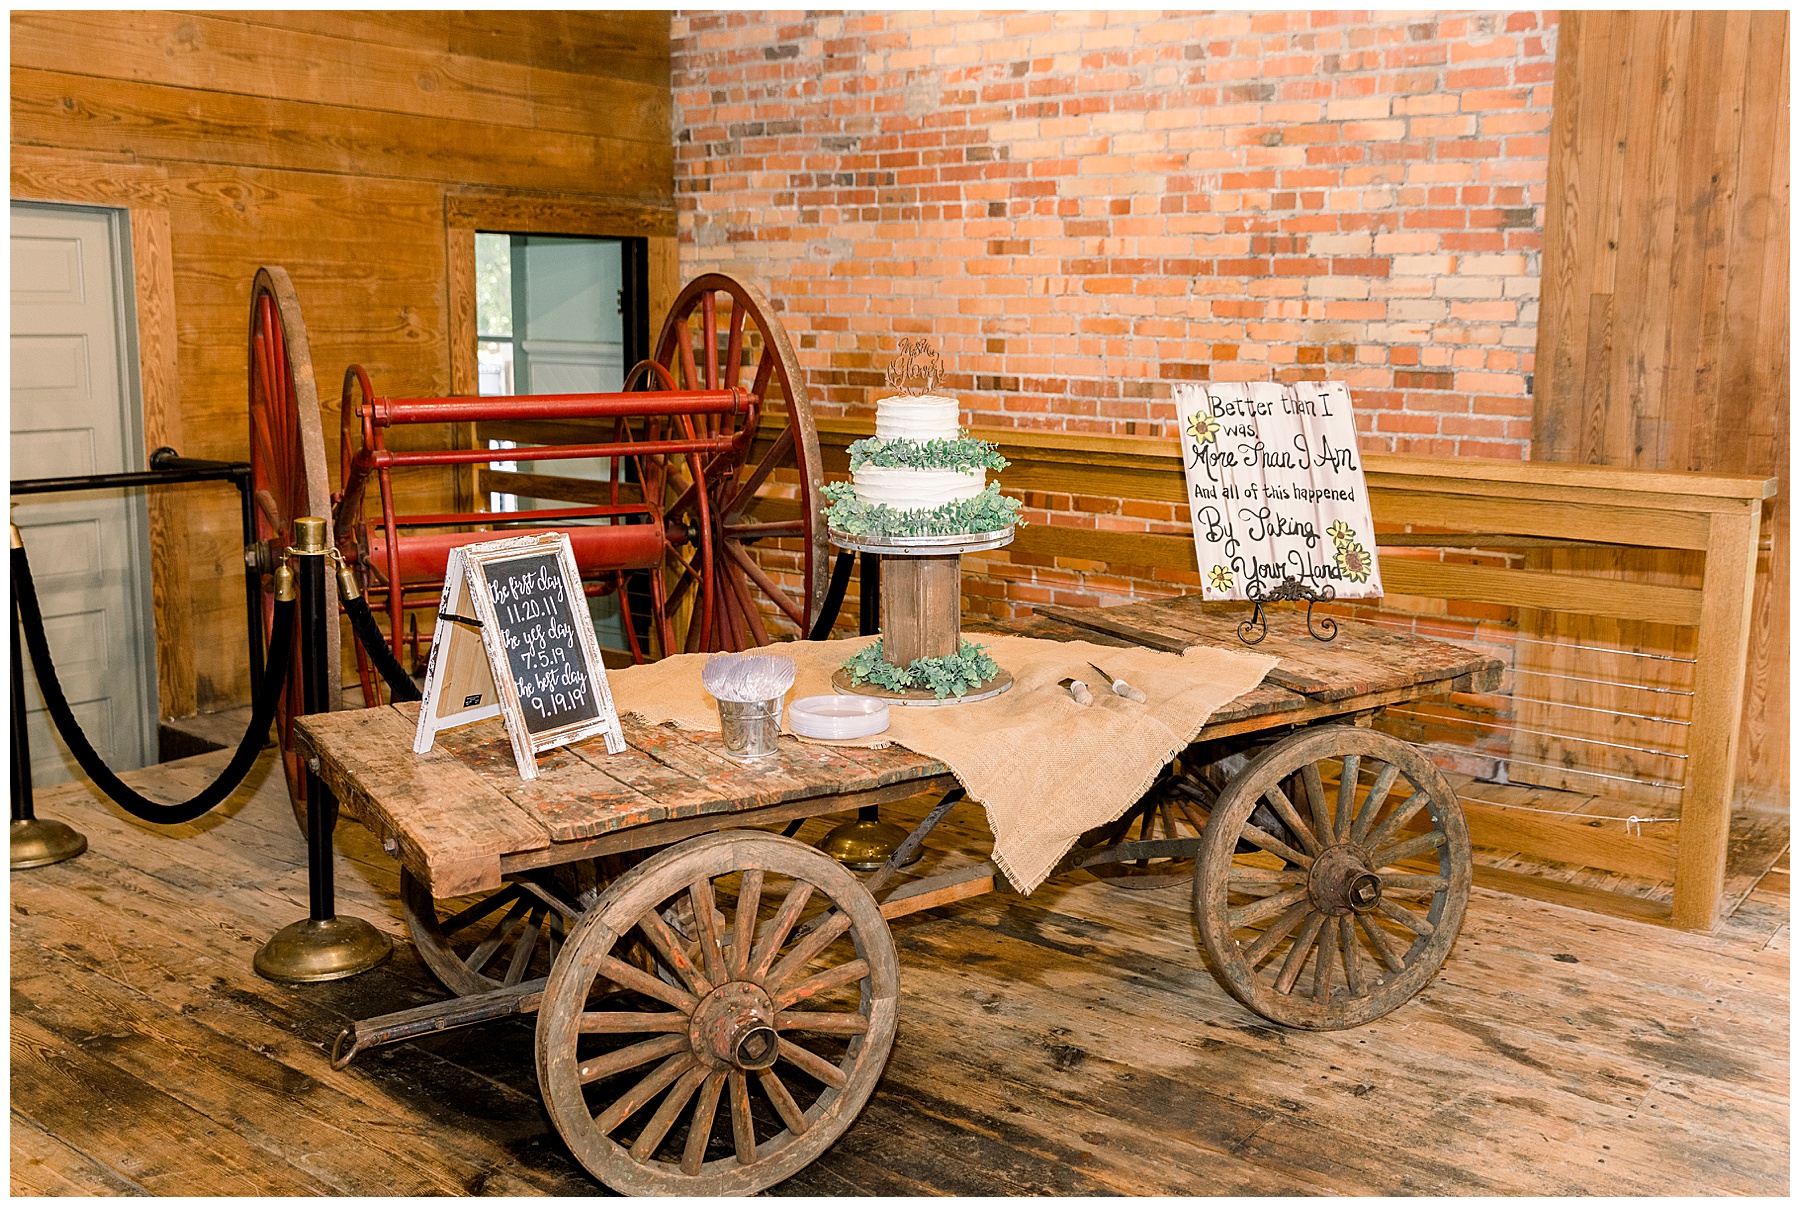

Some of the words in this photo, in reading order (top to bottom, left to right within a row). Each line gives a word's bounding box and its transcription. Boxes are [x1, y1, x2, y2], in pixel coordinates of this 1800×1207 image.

[1210, 396, 1274, 418] Better
[1281, 395, 1317, 417] than
[1318, 393, 1333, 417] I
[1189, 444, 1239, 482] More
[1238, 441, 1296, 469] Than
[1294, 433, 1311, 470] I
[1313, 434, 1358, 474] Am
[1194, 483, 1218, 500] And
[1221, 483, 1240, 500] all
[1243, 482, 1259, 500] of
[1263, 483, 1291, 500] this
[1292, 482, 1355, 504] happened
[1197, 505, 1241, 558] By
[1237, 506, 1320, 548] Taking
[488, 579, 510, 605] the
[508, 571, 537, 601] first
[537, 565, 564, 603] day
[1231, 556, 1287, 592] Your
[1287, 549, 1343, 588] Hand
[506, 595, 558, 624] 11.20.11
[501, 627, 521, 650] the
[524, 623, 546, 657] yes
[547, 616, 575, 649] day
[520, 647, 566, 670] 7.5.19
[514, 676, 535, 699] the
[534, 668, 561, 693] best
[560, 661, 588, 694] day
[531, 688, 585, 719] 9.19.19
